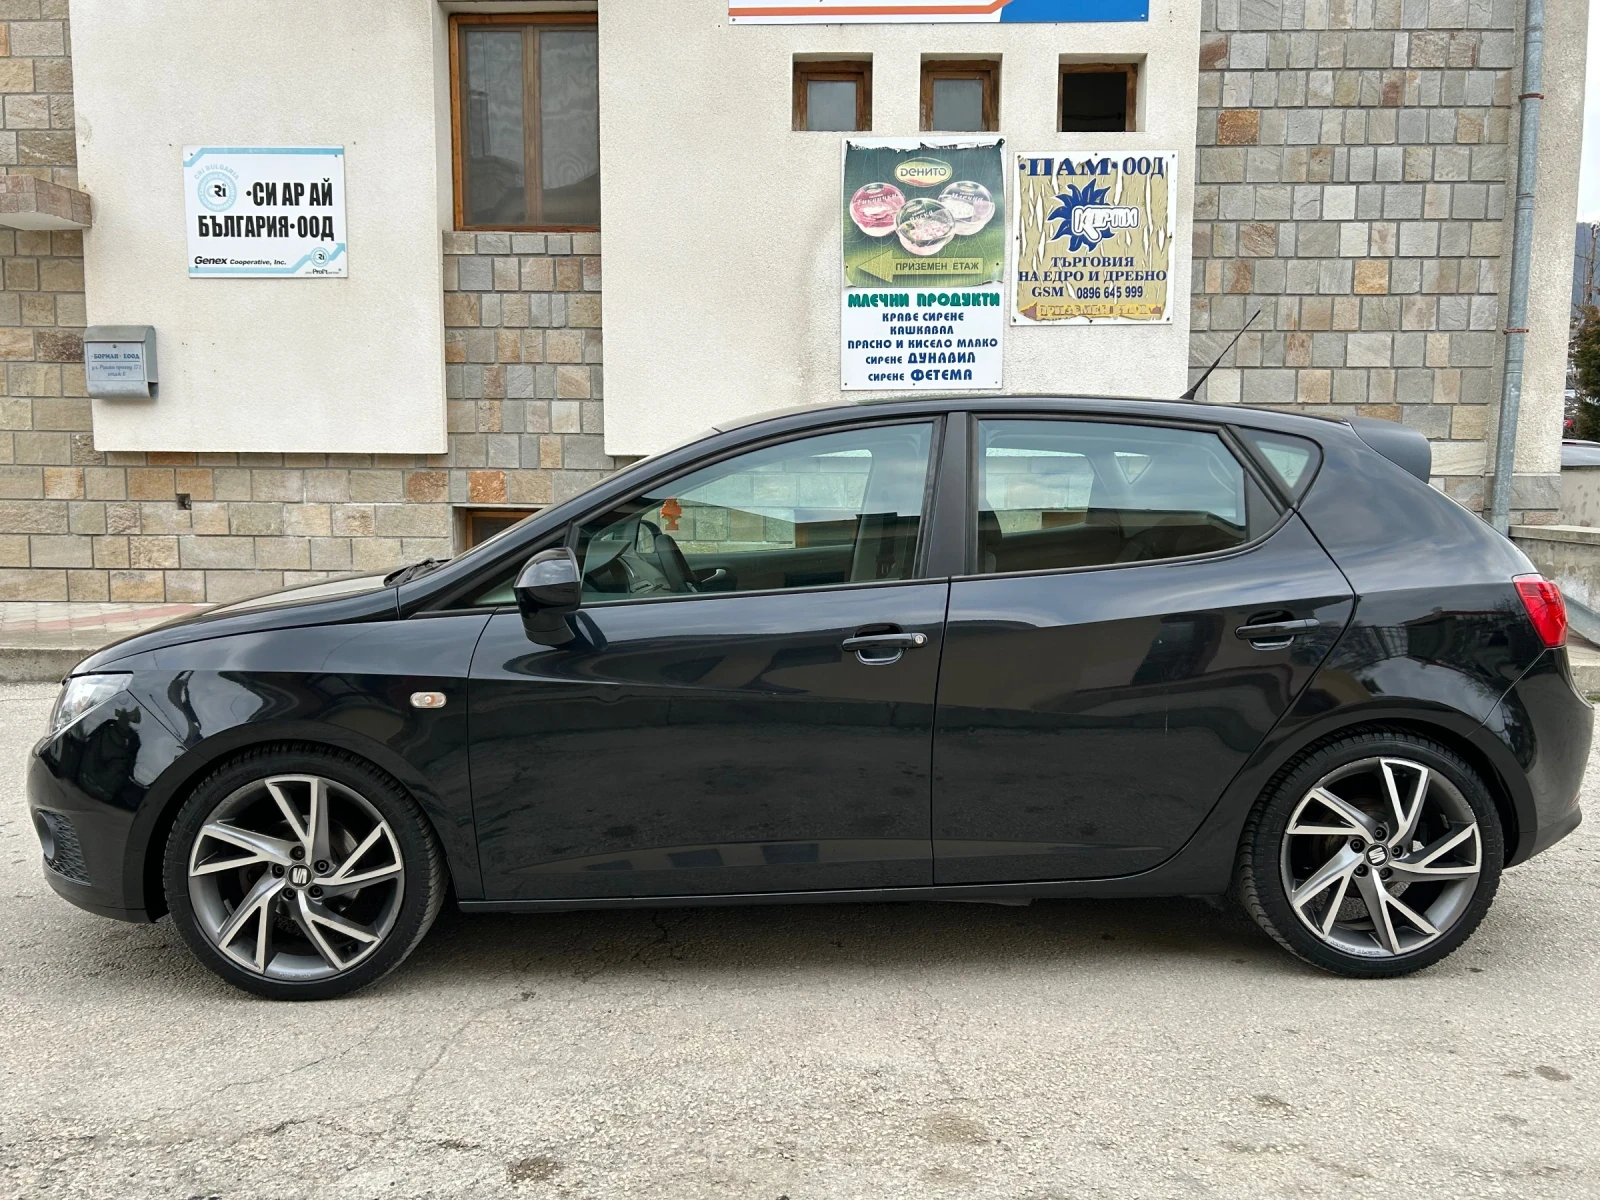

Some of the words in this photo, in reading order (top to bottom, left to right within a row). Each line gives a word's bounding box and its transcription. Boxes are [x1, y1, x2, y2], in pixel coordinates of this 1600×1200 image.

[205, 164, 239, 180] BULGARIA
[1122, 156, 1165, 180] ООД
[281, 182, 305, 206] АР
[309, 178, 333, 206] АЙ
[194, 255, 228, 265] Genex
[895, 262, 948, 271] ПРИЗЕМЕН
[952, 261, 979, 270] ЕТАЖ
[1051, 256, 1135, 268] ТЪРГОВИЯ
[1018, 271, 1039, 282] НА
[1042, 271, 1085, 284] ЕДРО
[1088, 271, 1100, 281] И
[1103, 270, 1167, 284] ДРЕБНО
[1031, 286, 1064, 298] GSM
[1076, 287, 1101, 299] 0896
[1104, 286, 1122, 299] 645
[1125, 286, 1143, 298] 999
[847, 293, 910, 308] МЛЕЧНИ
[916, 292, 1000, 307] ПРОДУКТИ
[882, 312, 919, 322] КРАВЕ
[922, 312, 965, 322] СИРЕНЕ
[890, 325, 954, 335] КАШКАВАЛ
[847, 339, 892, 349] ПРЯСНО
[896, 339, 904, 349] И
[908, 338, 953, 349] КИСЕЛО
[956, 338, 998, 348] МЛЯКО
[865, 355, 903, 365] СИРЕНЕ
[867, 372, 905, 382] СИРЕНЕ
[911, 368, 973, 381] ФЕТЕМА
